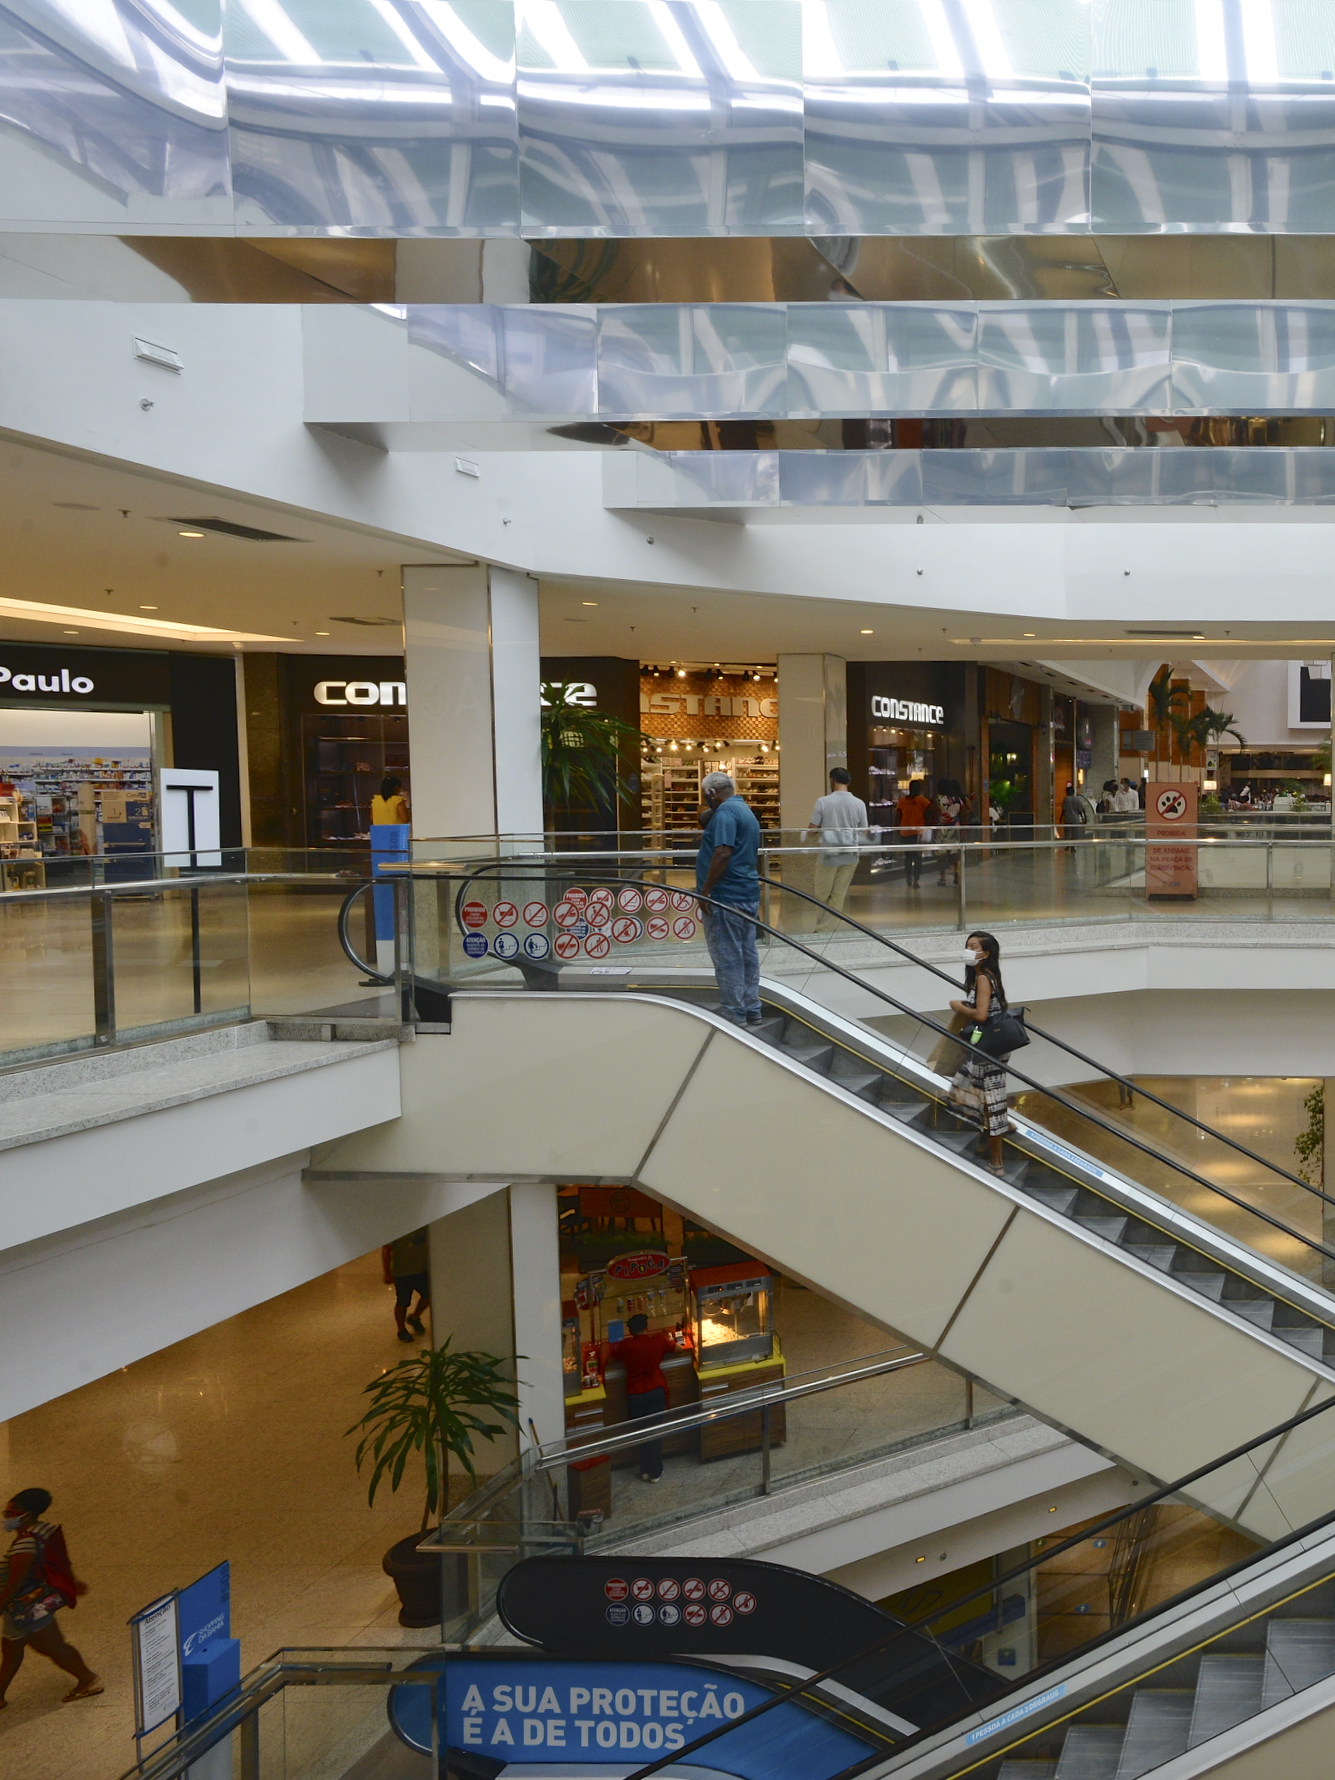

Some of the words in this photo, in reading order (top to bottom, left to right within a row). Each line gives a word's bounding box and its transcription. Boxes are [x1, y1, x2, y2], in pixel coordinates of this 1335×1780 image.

[872, 695, 944, 725] CONSTANCE
[144, 1604, 171, 1627] Atenção
[461, 1684, 485, 1712] A
[492, 1685, 562, 1714] SUA
[570, 1683, 745, 1725] PROTEÇÃO
[975, 1722, 1001, 1739] PESSOA
[1000, 1718, 1007, 1726] A
[1007, 1711, 1025, 1723] CADA
[1029, 1689, 1059, 1711] DEGRAUS
[462, 1707, 483, 1744] É
[490, 1718, 515, 1746] A
[523, 1719, 566, 1747] DE
[575, 1720, 685, 1750] TODOS
